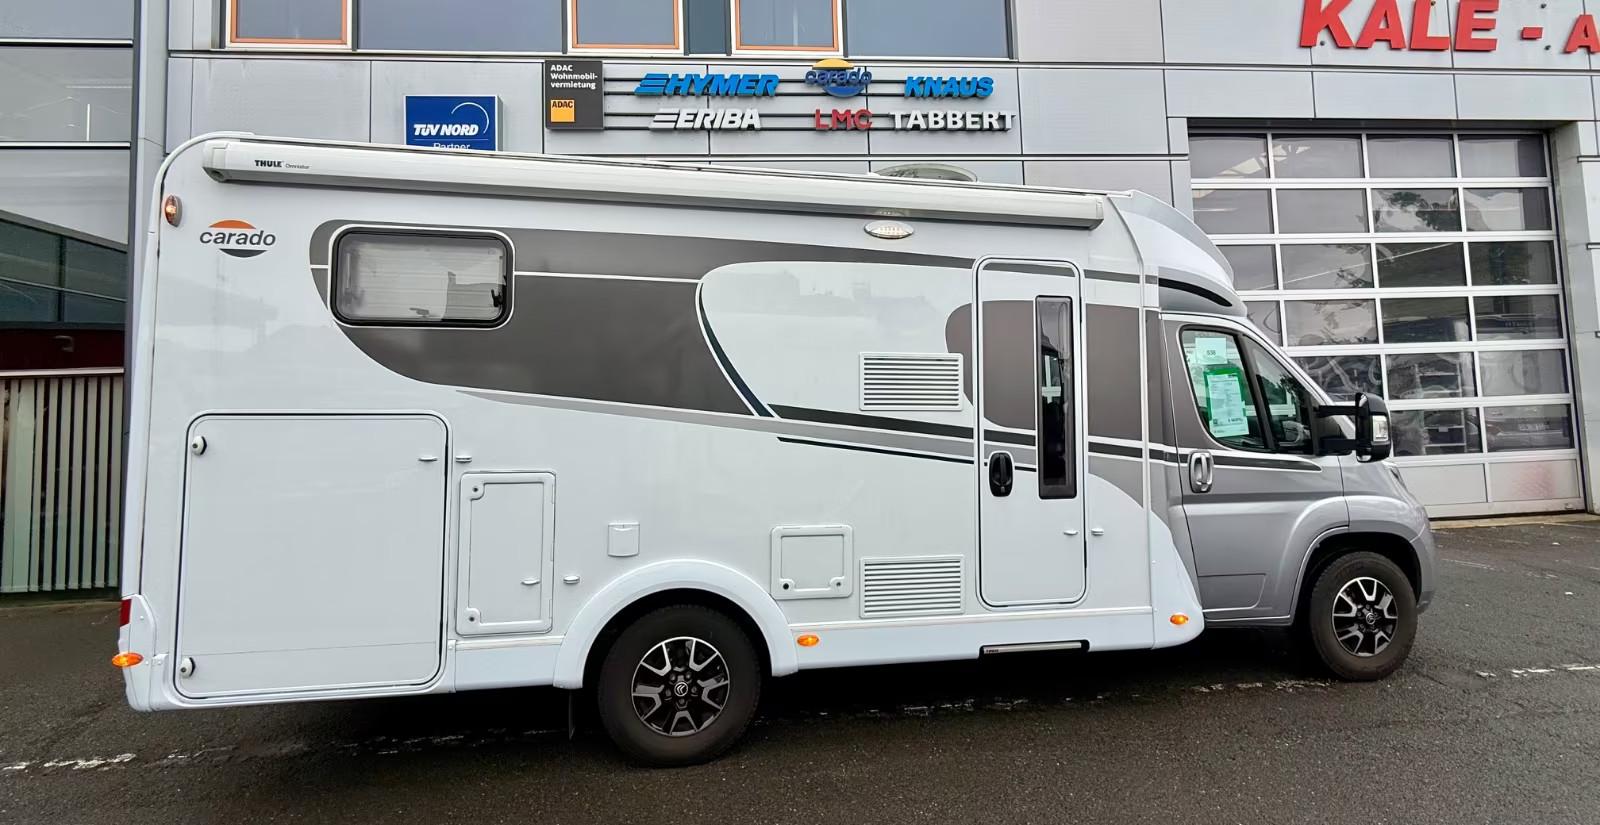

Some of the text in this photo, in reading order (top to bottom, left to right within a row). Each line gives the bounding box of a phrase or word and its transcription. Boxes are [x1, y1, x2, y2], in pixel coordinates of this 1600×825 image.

[1299, 0, 1499, 50] KALE
[550, 64, 574, 72] ADAC
[550, 72, 599, 80] Wohnmobil-
[805, 67, 873, 85] carado
[550, 81, 597, 90] vermietung
[664, 72, 780, 97] HYMER
[904, 75, 995, 98] KNAUS
[551, 101, 574, 109] ADAC
[675, 107, 762, 130] ERIBA
[814, 108, 874, 131] LMC
[888, 110, 1017, 131] TABBERT
[440, 124, 479, 136] NORD
[254, 159, 283, 168] THULE
[199, 230, 276, 246] carado
